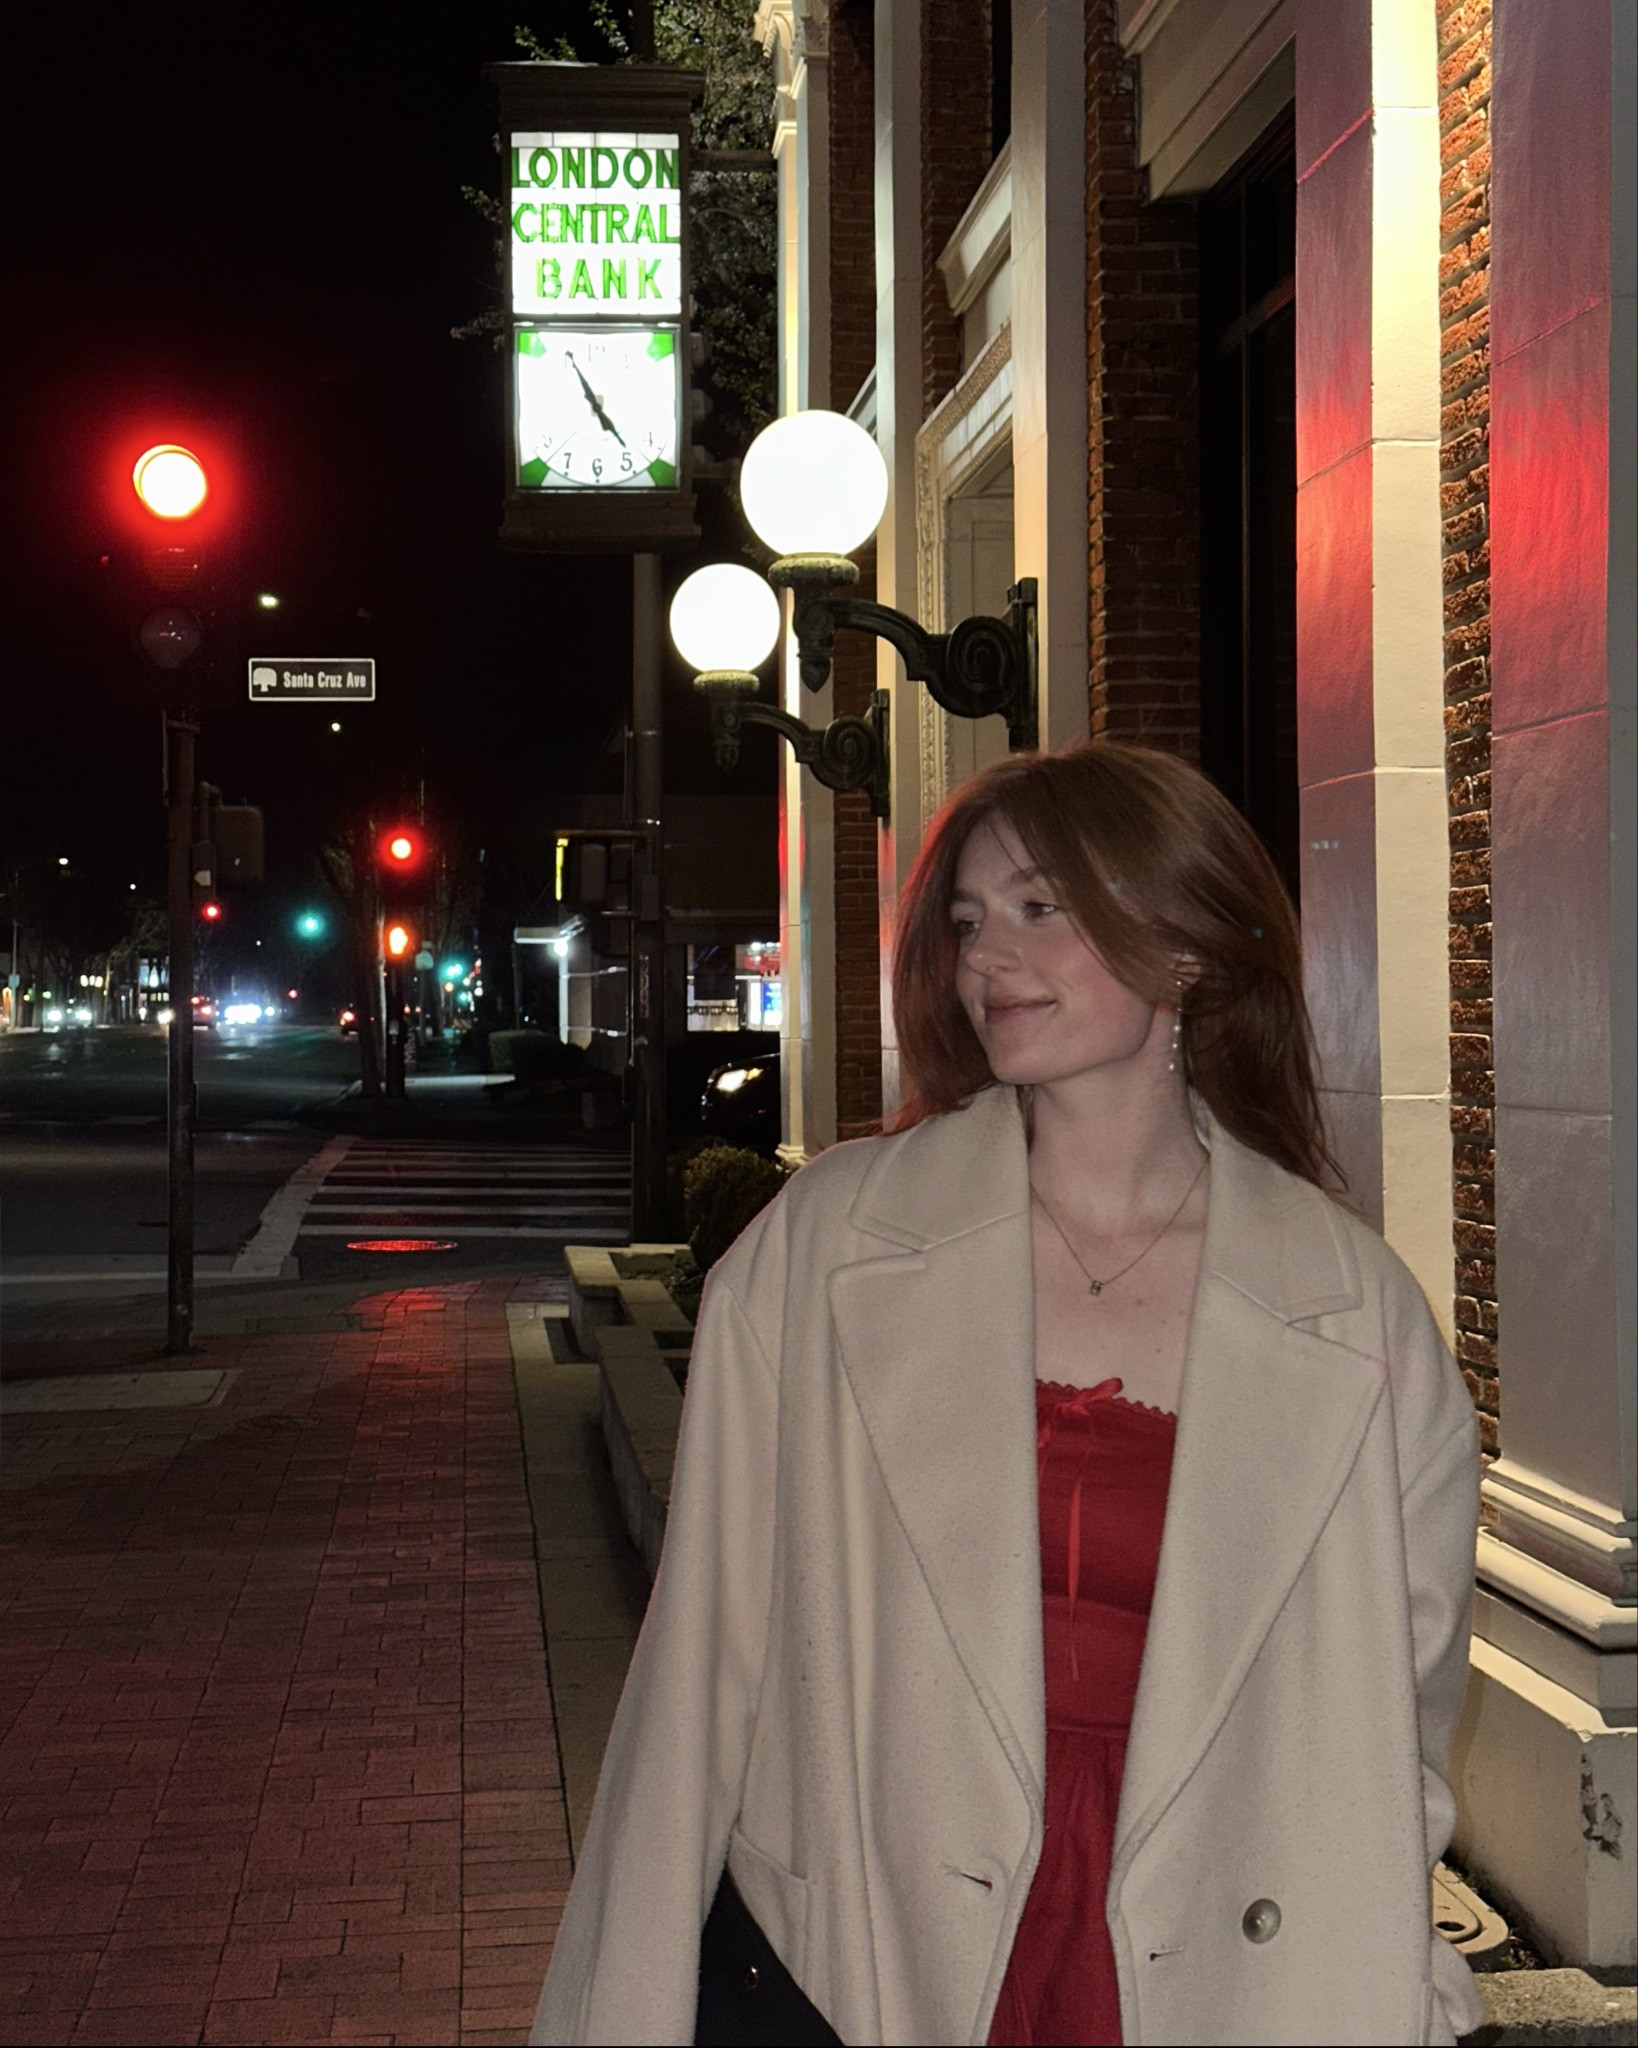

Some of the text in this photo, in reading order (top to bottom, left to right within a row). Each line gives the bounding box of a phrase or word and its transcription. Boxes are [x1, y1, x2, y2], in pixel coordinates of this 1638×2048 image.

[511, 147, 680, 189] LONDON
[511, 203, 680, 243] CENTRAL
[535, 258, 663, 299] BANK
[563, 452, 572, 470] 7
[592, 458, 603, 478] 6
[620, 452, 633, 472] 5
[283, 671, 367, 688] Santa Cruz Ave
